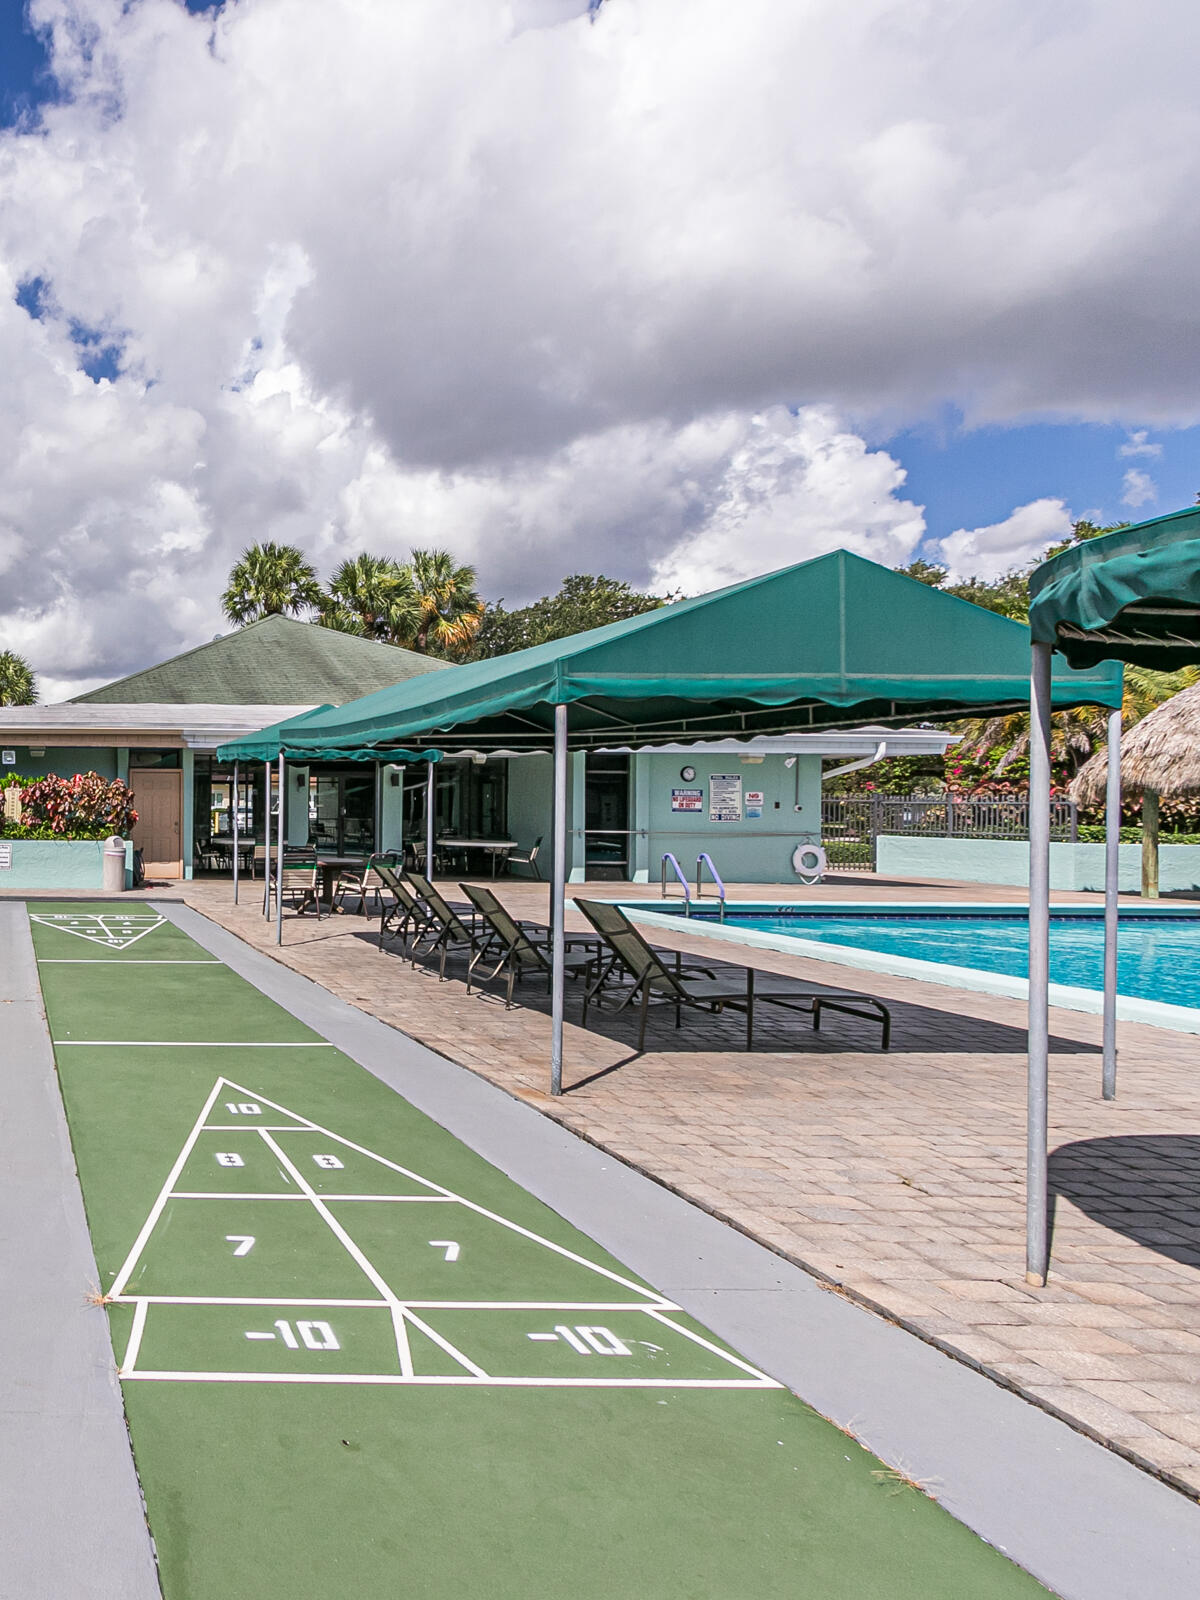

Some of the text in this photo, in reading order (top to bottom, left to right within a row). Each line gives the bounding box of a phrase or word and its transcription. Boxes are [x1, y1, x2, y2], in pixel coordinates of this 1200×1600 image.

[225, 1102, 263, 1115] 10
[215, 1152, 246, 1167] 8
[312, 1154, 345, 1169] 8
[225, 1235, 256, 1257] 7
[428, 1240, 461, 1262] 7
[243, 1319, 341, 1350] -10
[526, 1324, 633, 1356] -10
